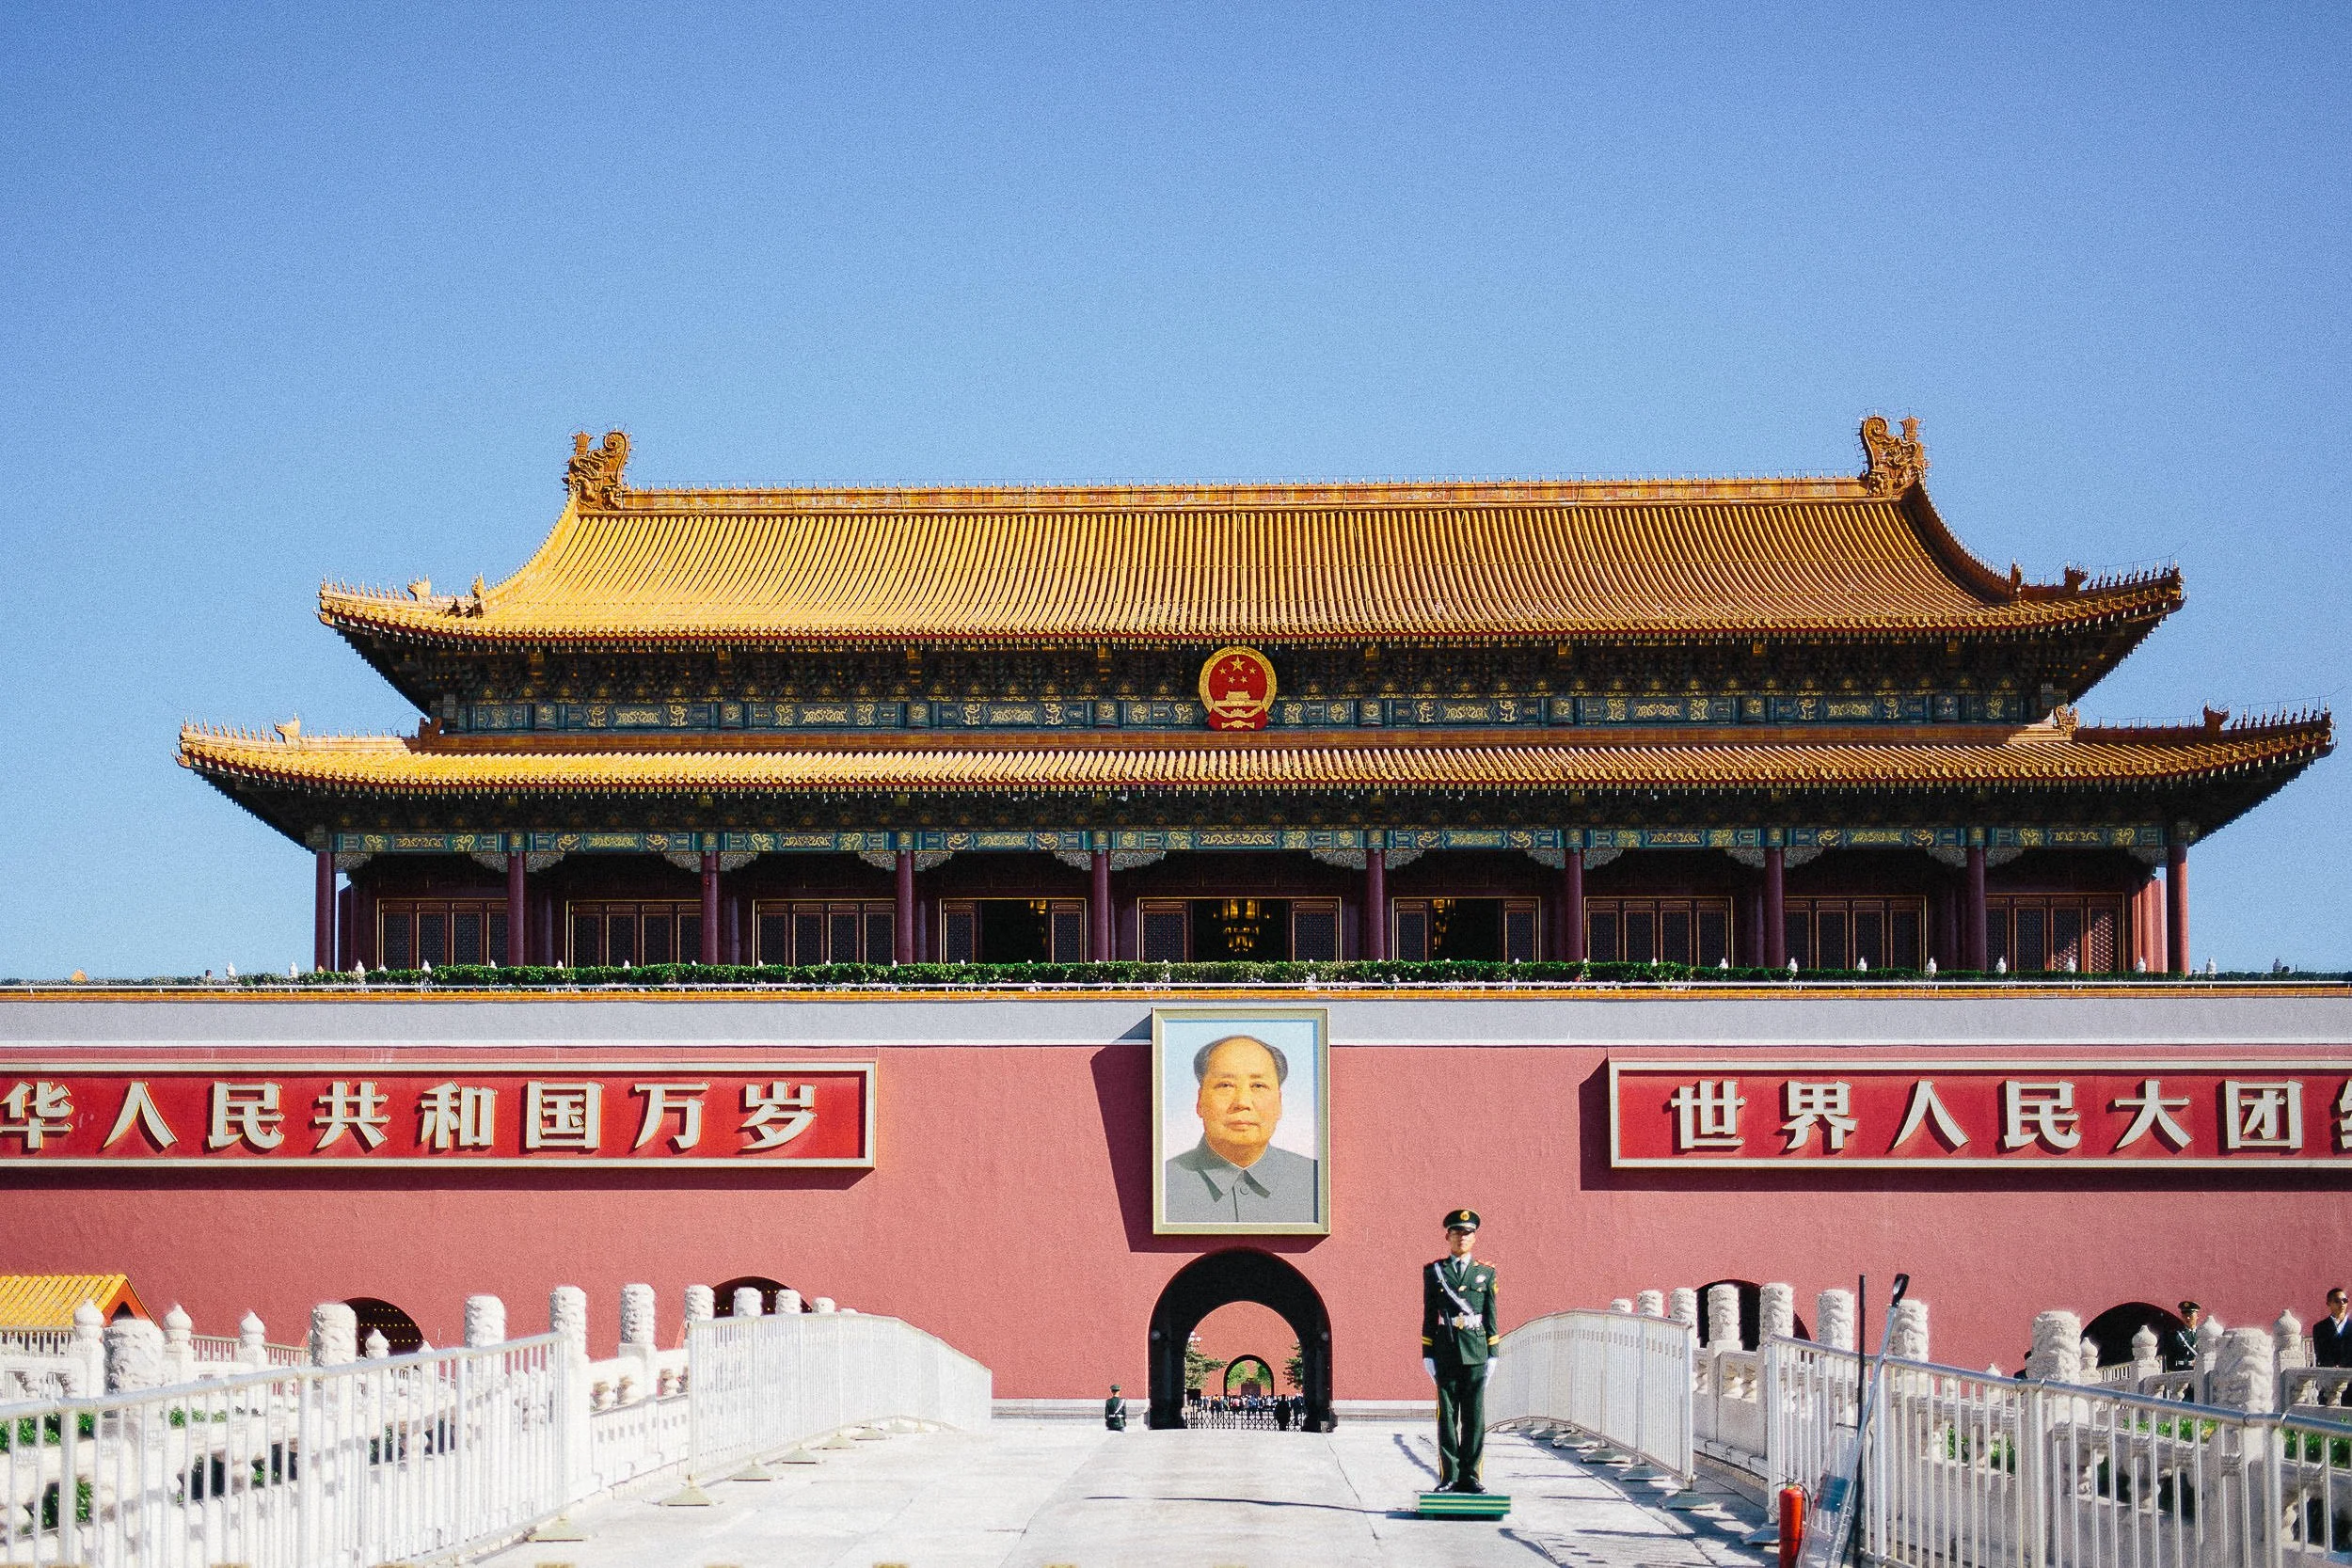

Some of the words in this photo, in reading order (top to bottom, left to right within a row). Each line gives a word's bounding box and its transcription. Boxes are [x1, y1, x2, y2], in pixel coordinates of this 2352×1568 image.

[0, 1080, 818, 1149] 华人民共和国万岁
[1670, 1079, 2352, 1149] 世界人民大团
